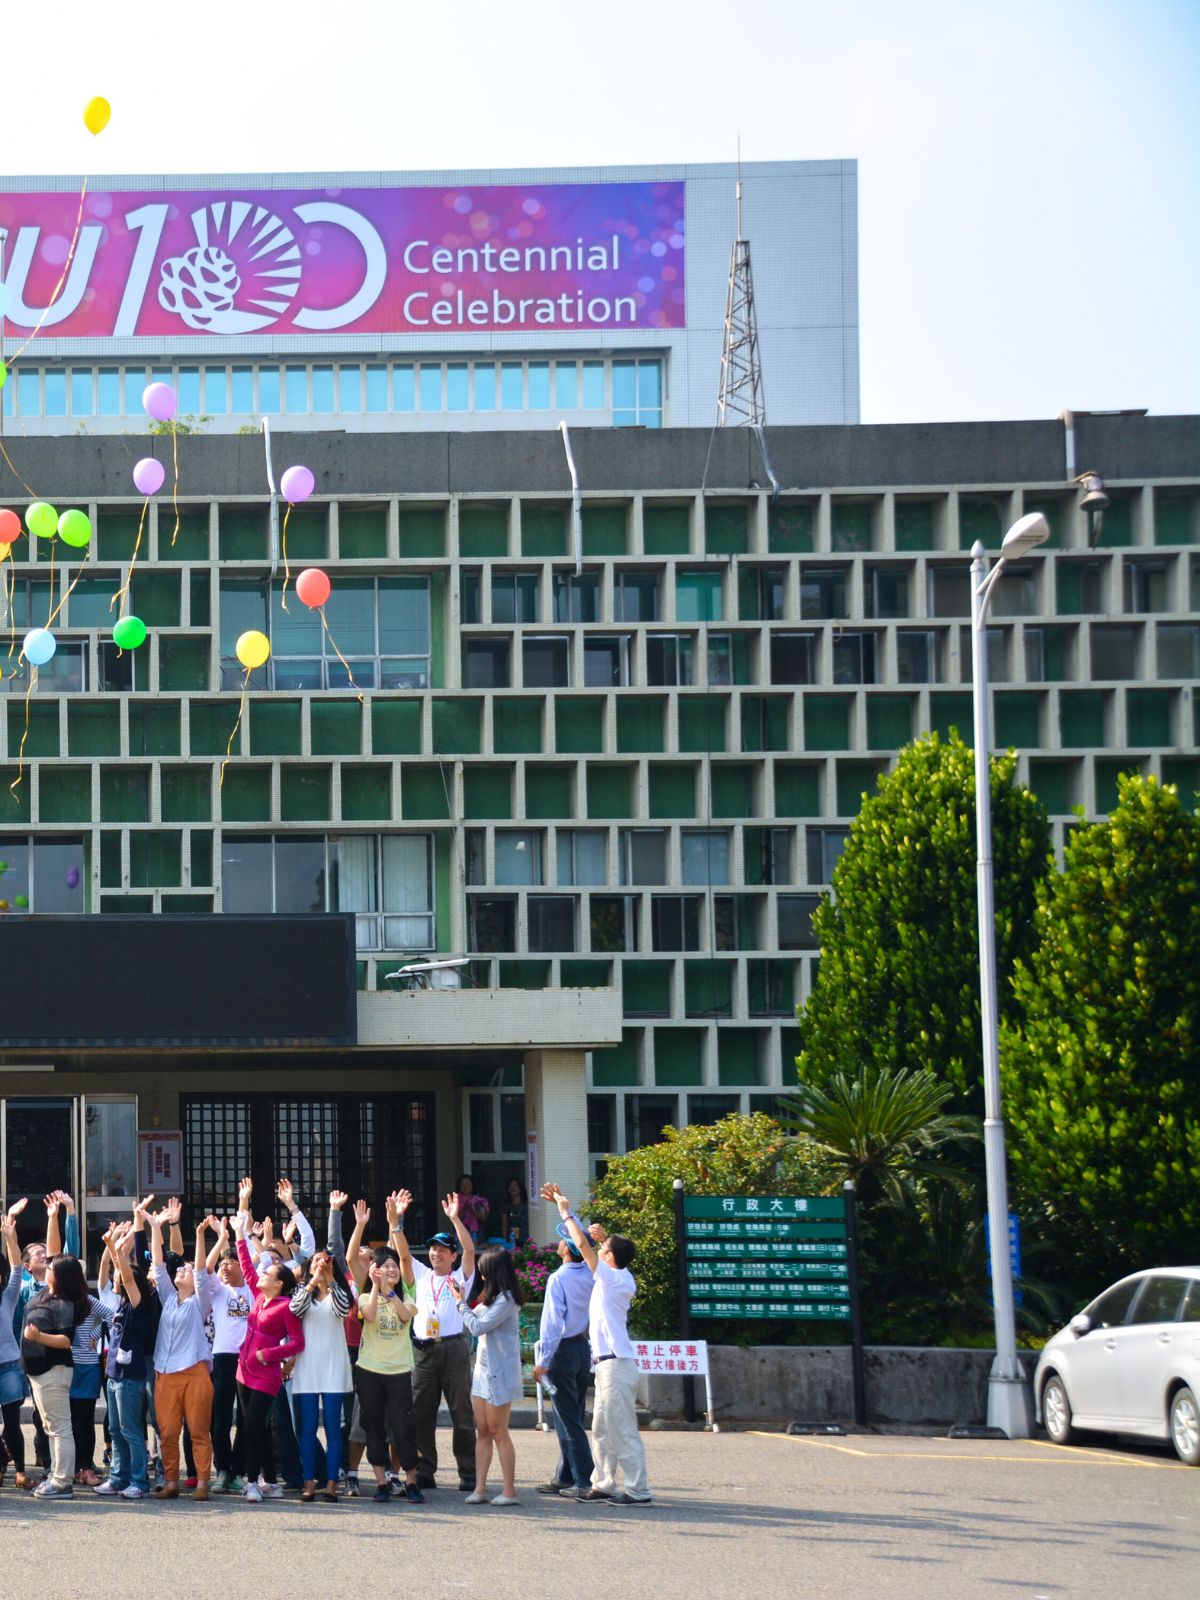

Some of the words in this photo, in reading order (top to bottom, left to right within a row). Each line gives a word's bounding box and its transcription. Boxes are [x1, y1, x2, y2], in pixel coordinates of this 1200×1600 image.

[403, 235, 619, 274] Centennial
[403, 289, 637, 325] Celebration
[722, 1198, 807, 1211] 行政大樓
